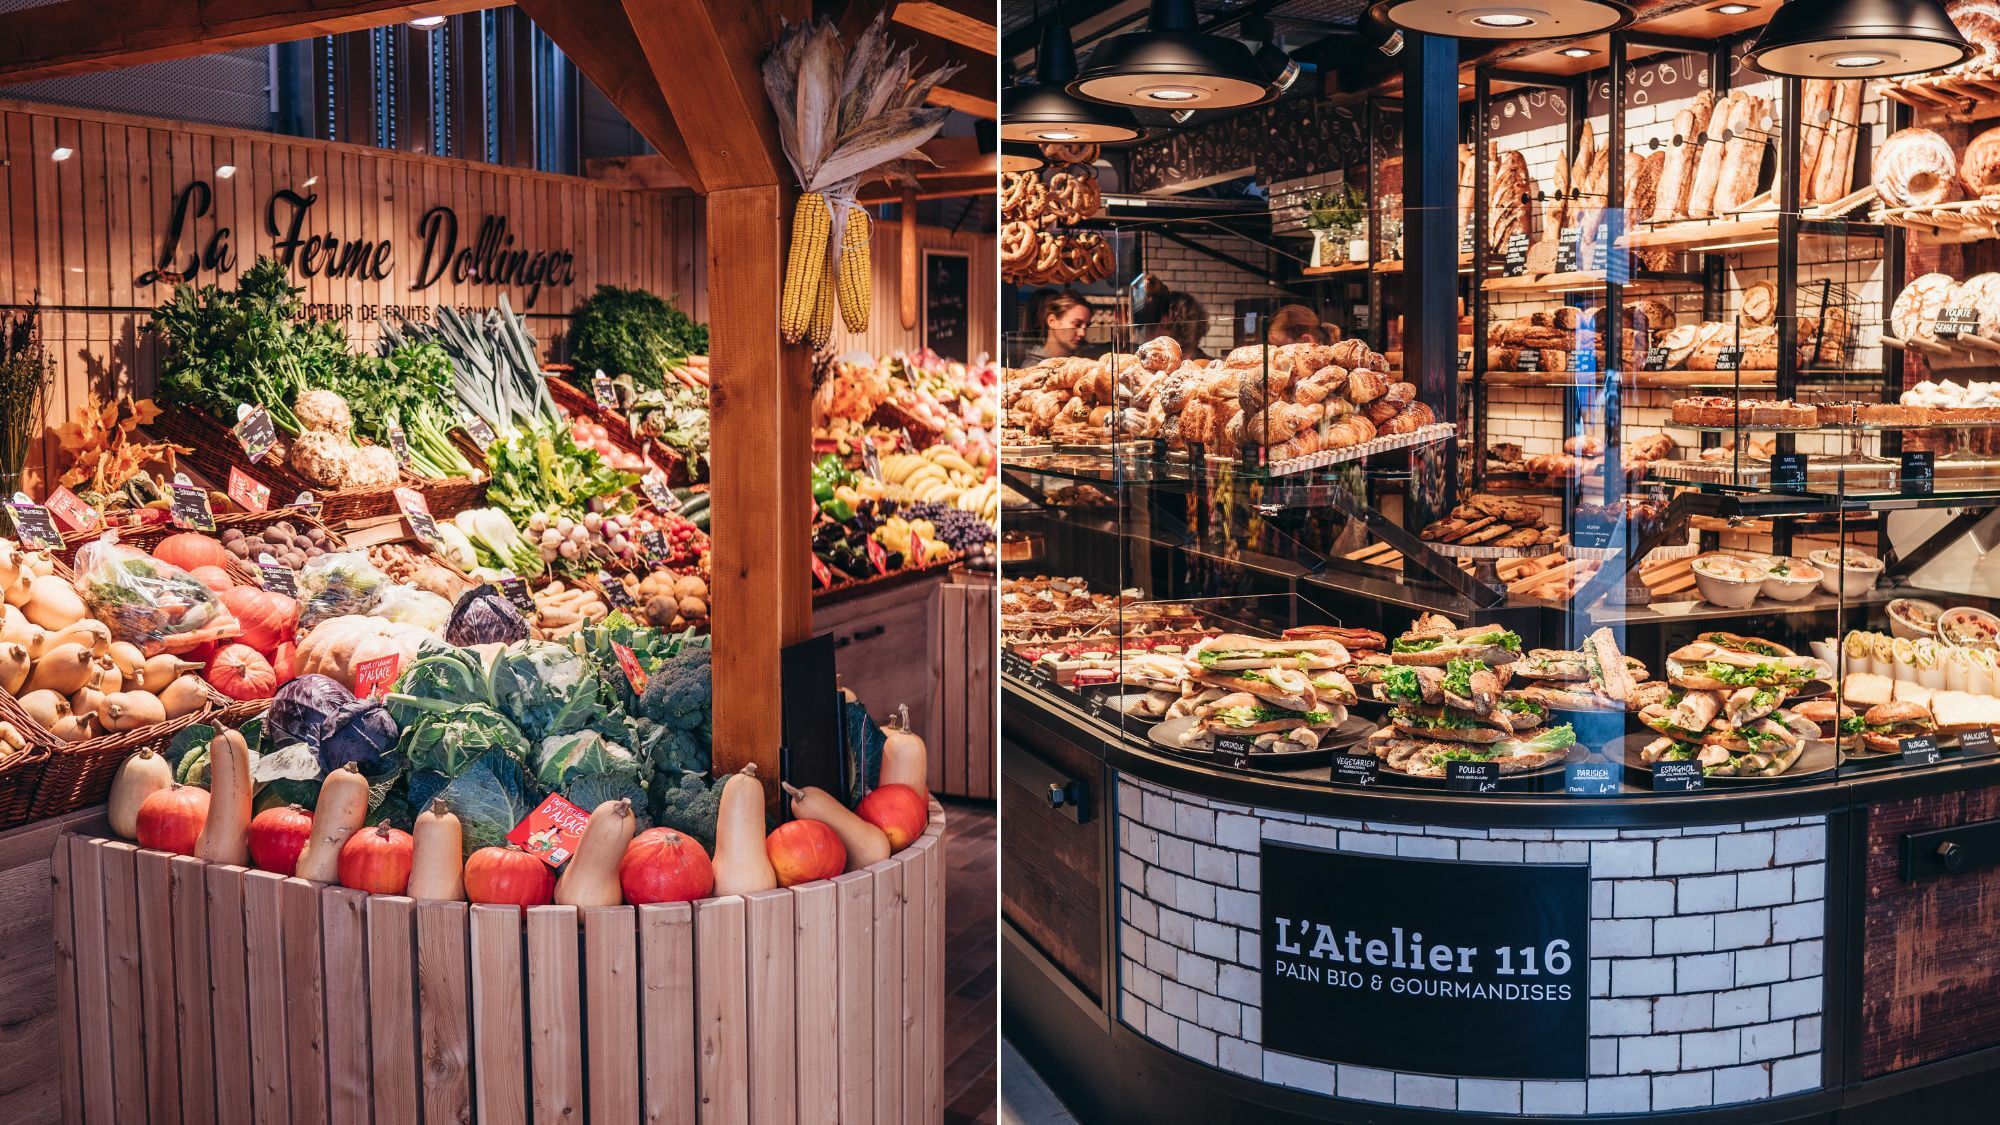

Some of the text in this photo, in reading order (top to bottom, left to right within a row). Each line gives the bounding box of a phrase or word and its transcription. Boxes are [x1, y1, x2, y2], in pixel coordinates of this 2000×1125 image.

[135, 181, 576, 308] La Ferme Dollinger
[362, 304, 378, 321] DE
[385, 304, 431, 321] FRUITS
[1945, 308, 1972, 317] TOURTE
[1934, 322, 1958, 333] SEIGLE
[360, 666, 392, 684] D'ALSACE
[1220, 740, 1244, 751] NORDIQUE
[1908, 740, 1930, 750] BURGER
[1336, 757, 1376, 768] VEGETARIEN
[1458, 765, 1486, 774] POULET
[1576, 770, 1608, 778] PARISIEN
[1660, 764, 1696, 774] ESPAGNOL
[541, 804, 586, 835] D'ALSACE
[1275, 917, 1572, 975] L'Atelier 116
[1276, 960, 1572, 1001] PAIN BIO & GOURMANDISES
